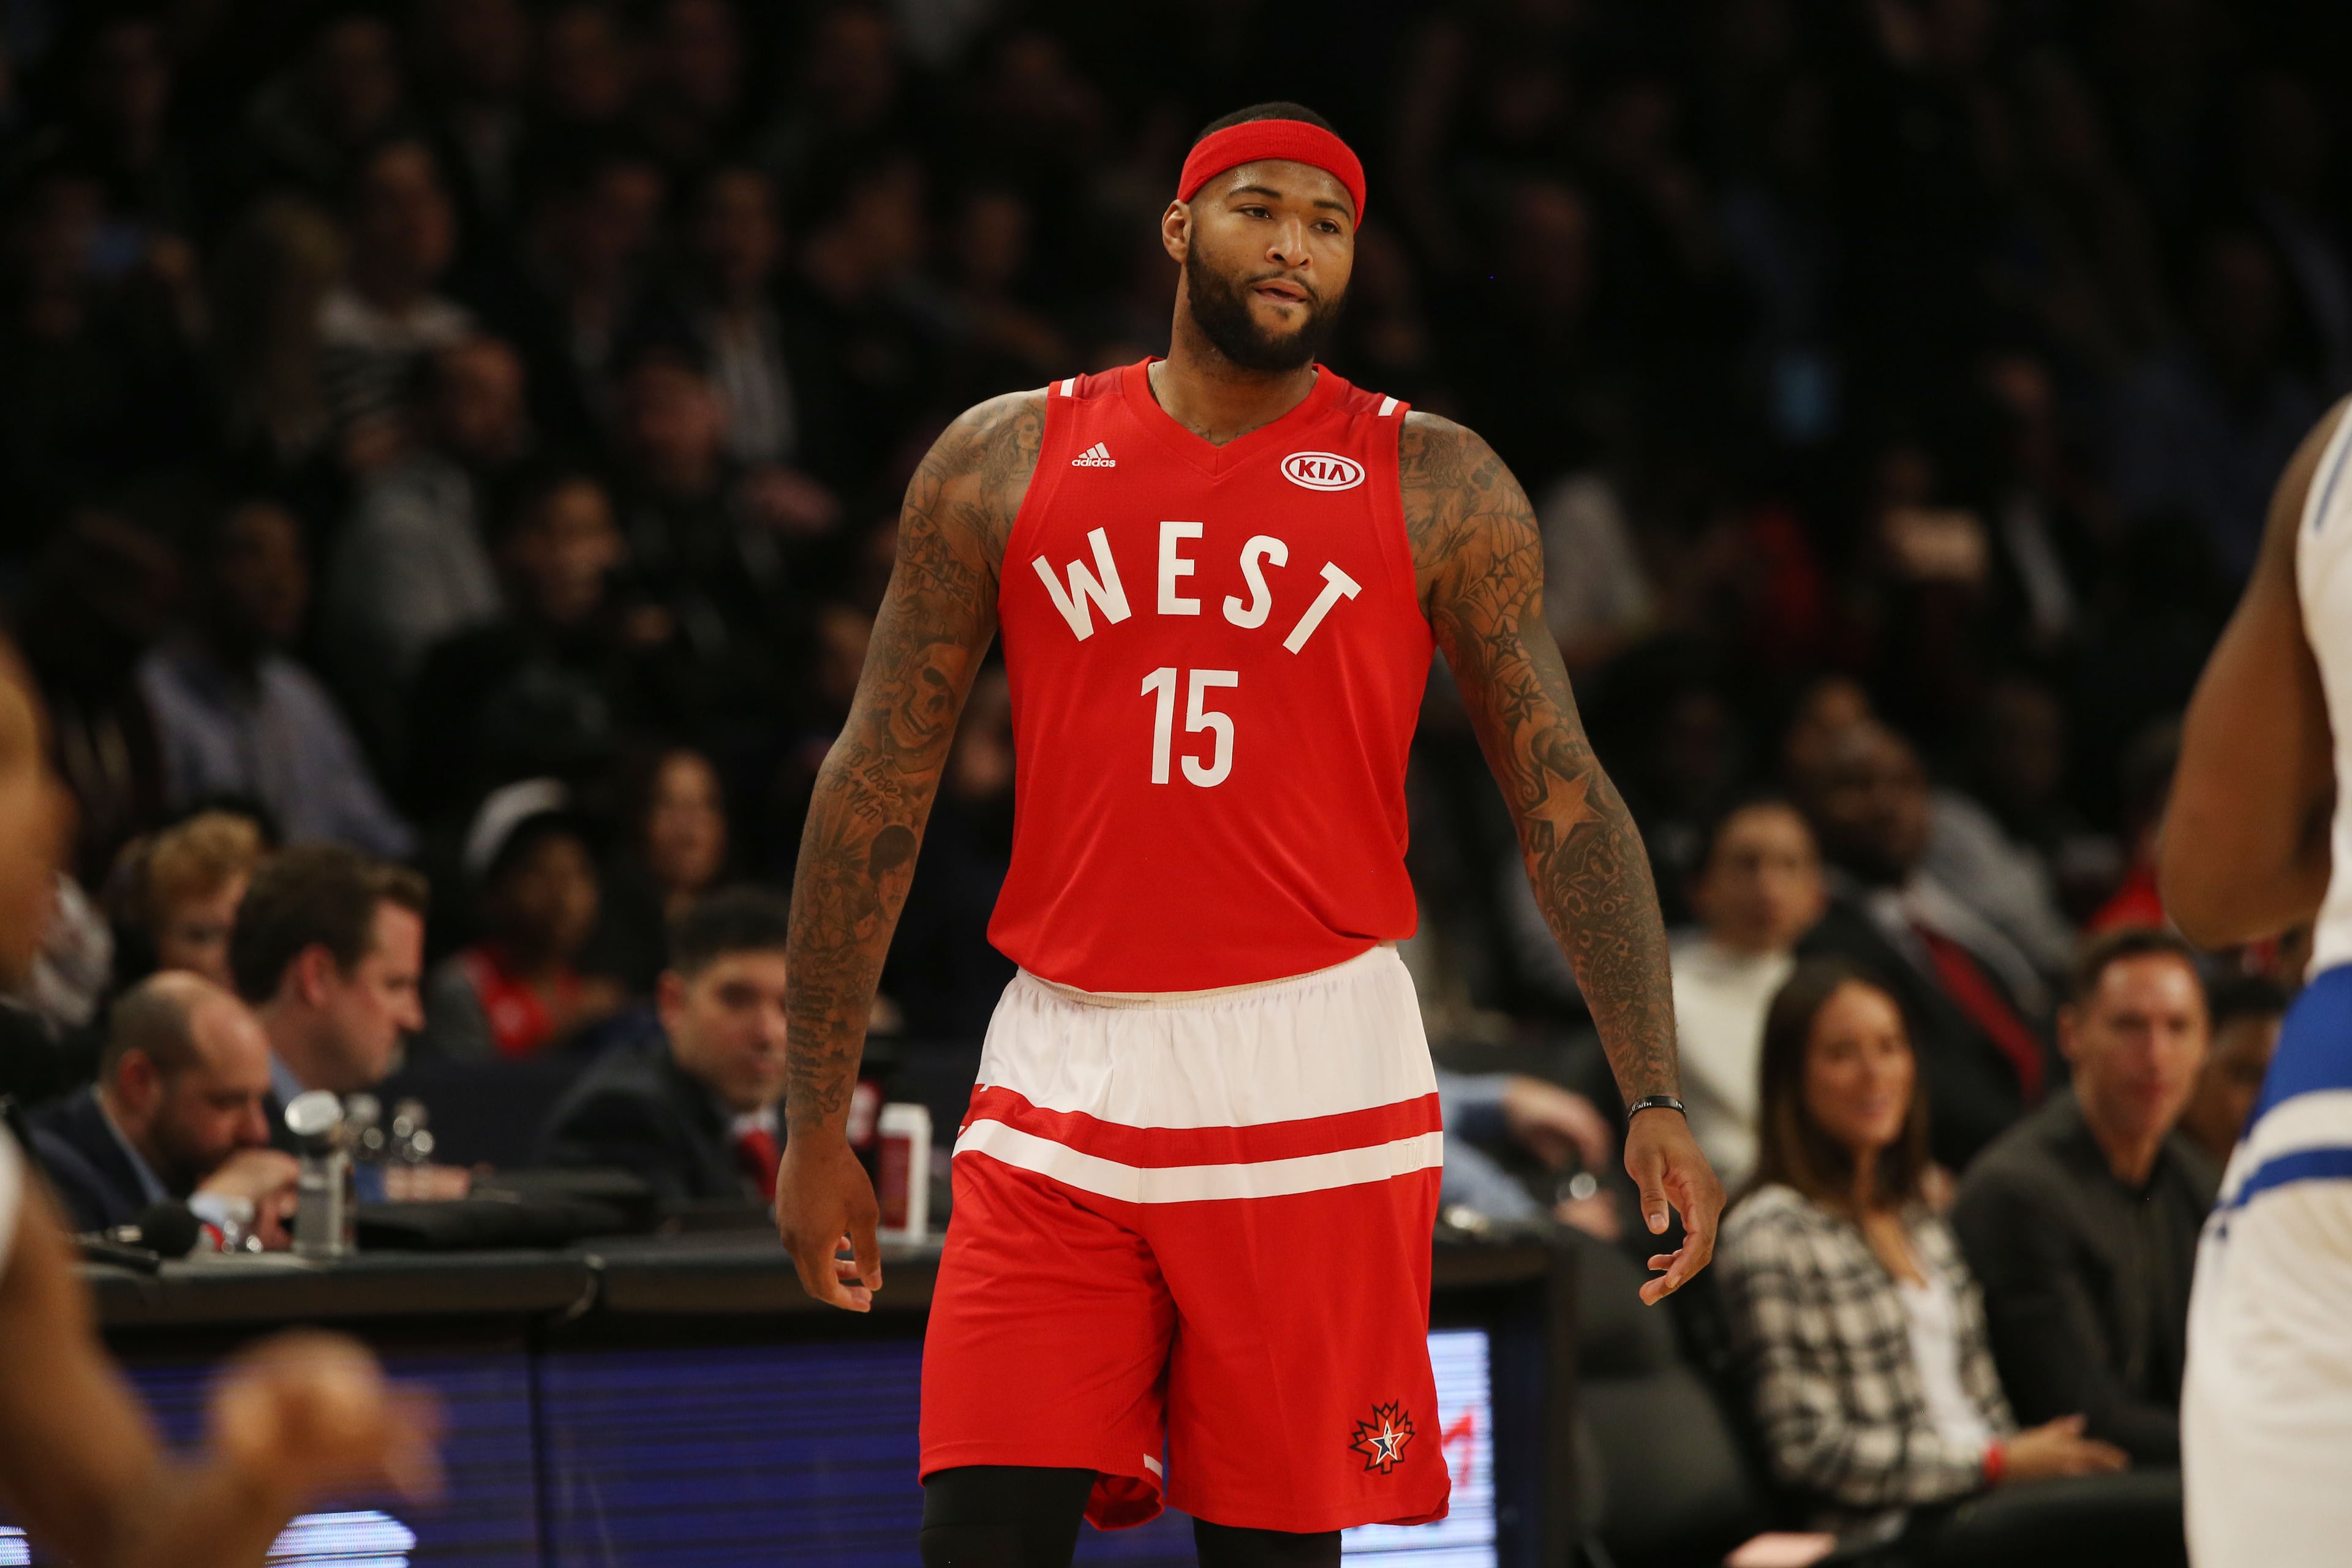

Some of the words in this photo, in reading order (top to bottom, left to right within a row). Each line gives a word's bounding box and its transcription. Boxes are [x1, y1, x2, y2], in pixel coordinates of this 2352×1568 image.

[1071, 457, 1116, 468] adidas
[1298, 459, 1346, 481] KIA
[1031, 521, 1362, 655] WEST
[1140, 666, 1238, 788] 15
